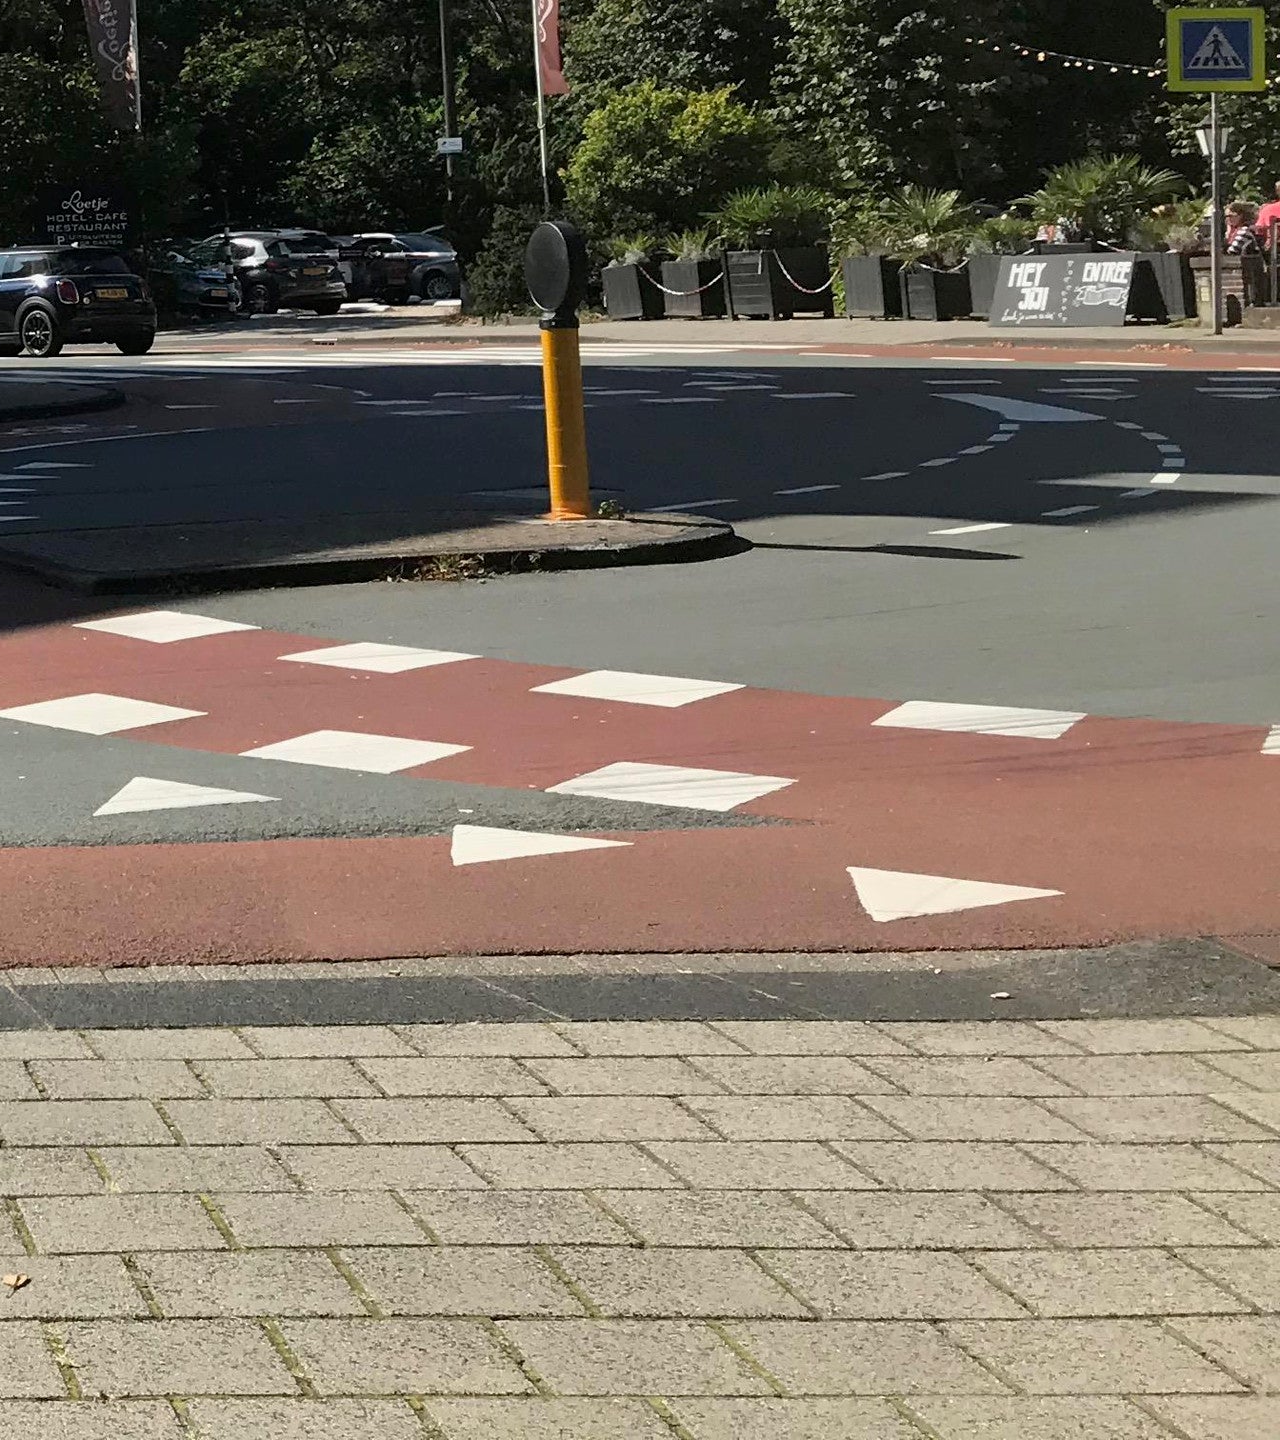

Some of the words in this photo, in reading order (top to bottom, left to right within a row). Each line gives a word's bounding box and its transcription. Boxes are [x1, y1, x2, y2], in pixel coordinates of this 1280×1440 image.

[61, 190, 109, 214] Loetje
[46, 214, 88, 222] HOTEL
[46, 222, 128, 232] RESTAURANT
[1008, 262, 1047, 288] HEY
[1082, 261, 1133, 284] ENTREE
